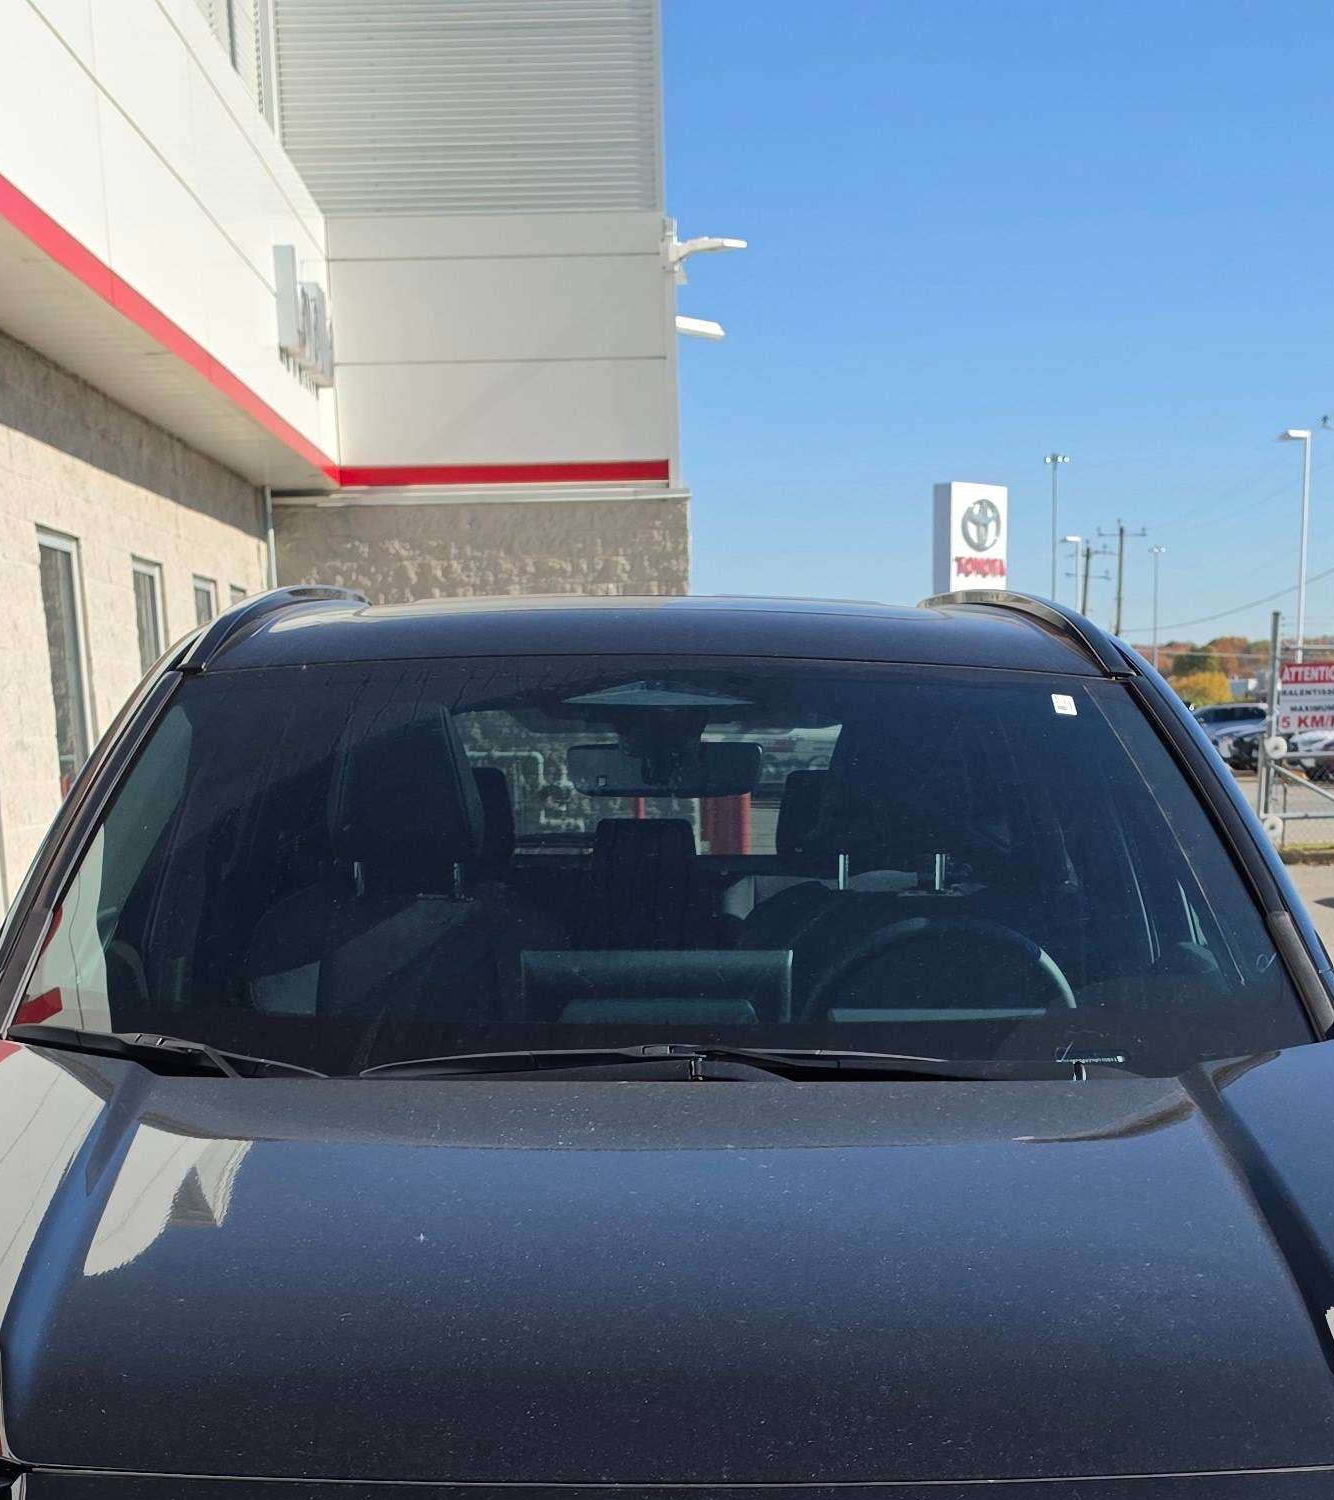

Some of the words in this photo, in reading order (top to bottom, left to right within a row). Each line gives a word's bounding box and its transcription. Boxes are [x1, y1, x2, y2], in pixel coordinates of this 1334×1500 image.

[955, 556, 1006, 577] TOYOTA
[1290, 704, 1334, 712] MAXIMUM
[1281, 715, 1291, 728] 5
